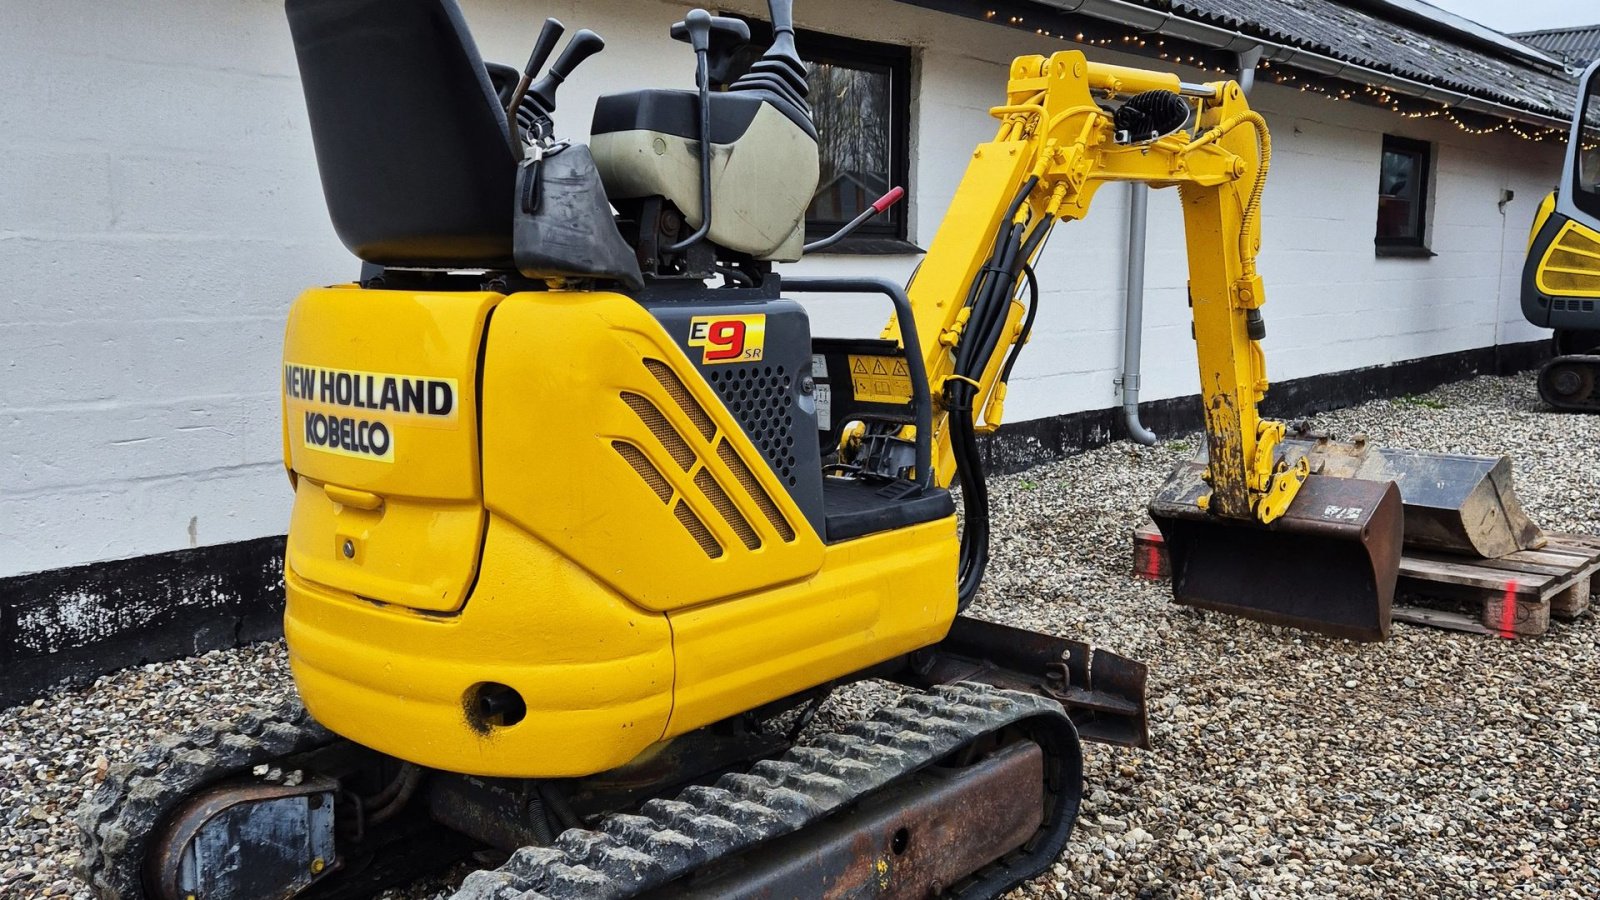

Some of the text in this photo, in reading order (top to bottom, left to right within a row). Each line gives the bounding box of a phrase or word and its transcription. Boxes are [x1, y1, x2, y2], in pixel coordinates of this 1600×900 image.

[285, 365, 453, 416] NEW HOLLAND
[305, 411, 390, 456] KOBELCO
